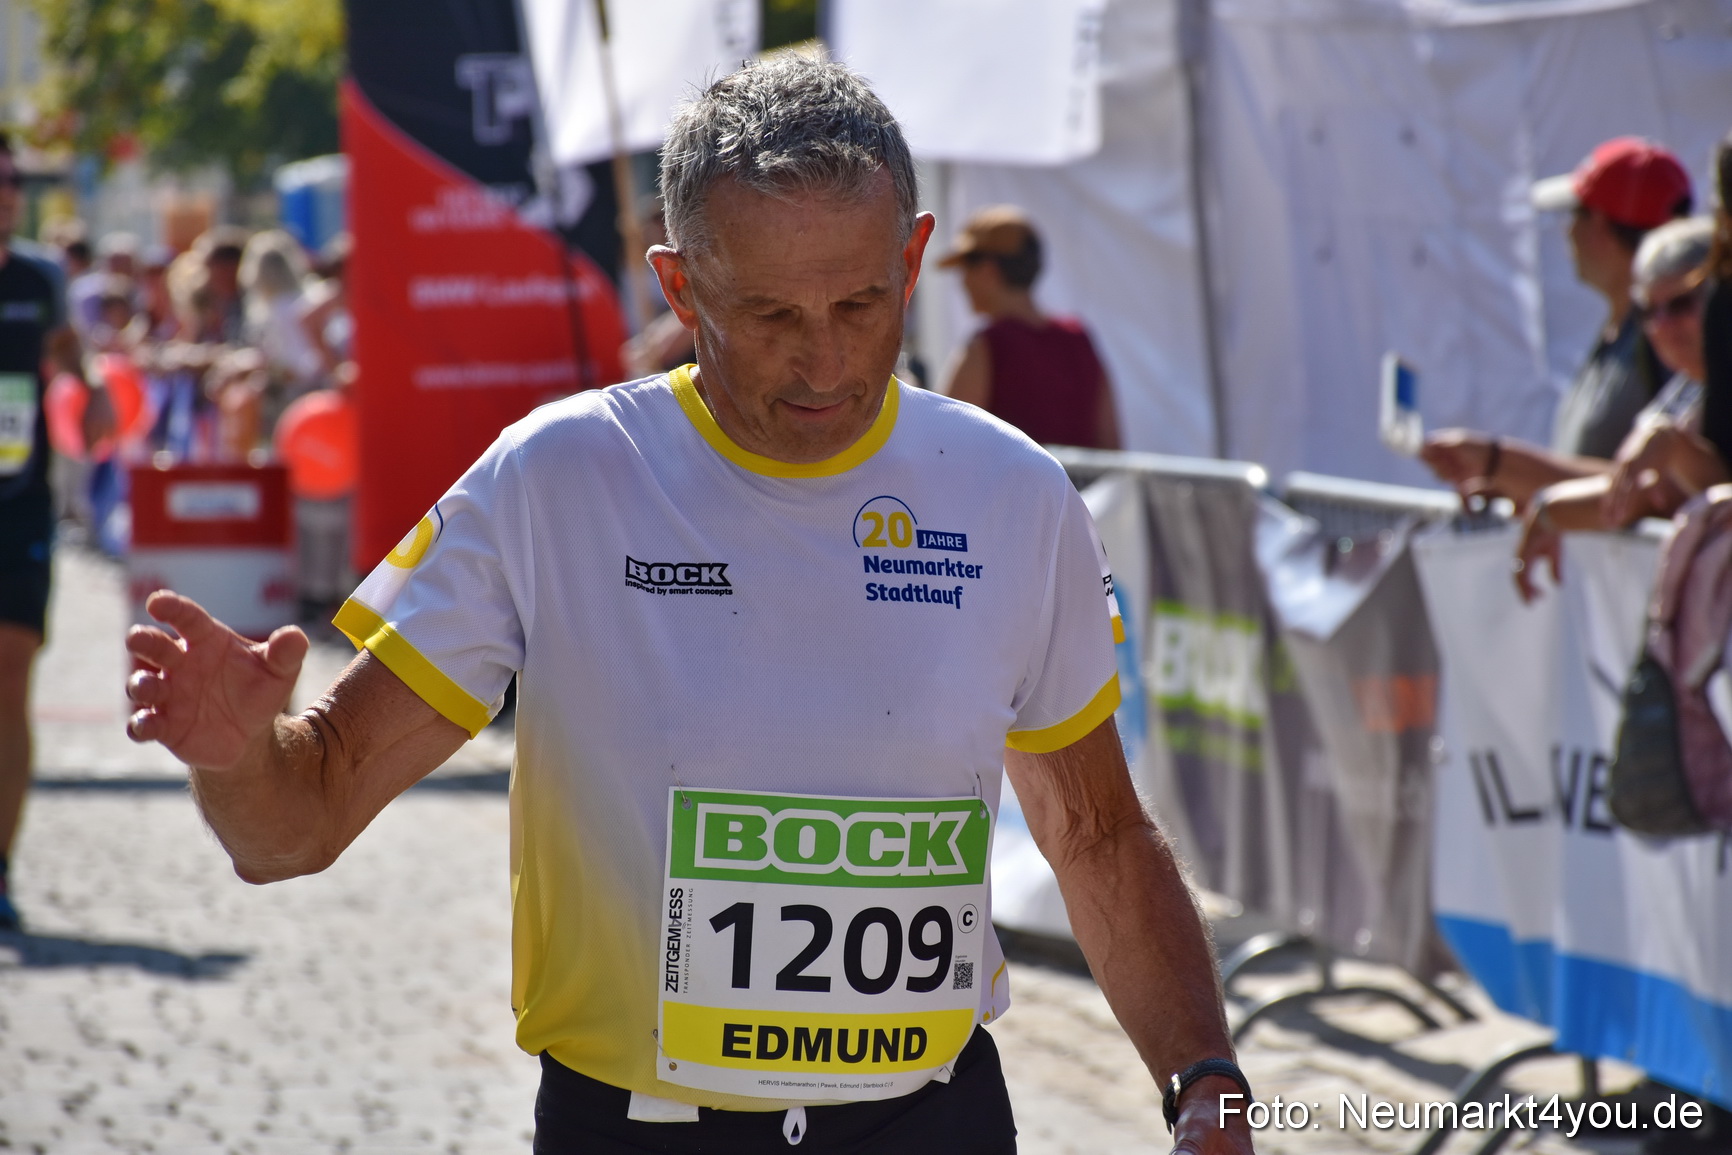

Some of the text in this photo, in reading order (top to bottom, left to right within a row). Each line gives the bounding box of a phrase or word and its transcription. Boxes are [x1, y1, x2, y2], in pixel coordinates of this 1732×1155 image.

[862, 511, 963, 548] 20 JAHRE
[625, 555, 732, 587] BOCK
[863, 555, 983, 579] Neumarkter
[625, 579, 733, 597] inspired by smart concepts
[865, 582, 963, 609] Stadtlauf
[695, 802, 972, 877] BOCK
[683, 888, 694, 994] TRANSPONDER ZEITMESSUNG
[709, 902, 954, 995] 1209
[721, 1023, 928, 1063] EDMUND
